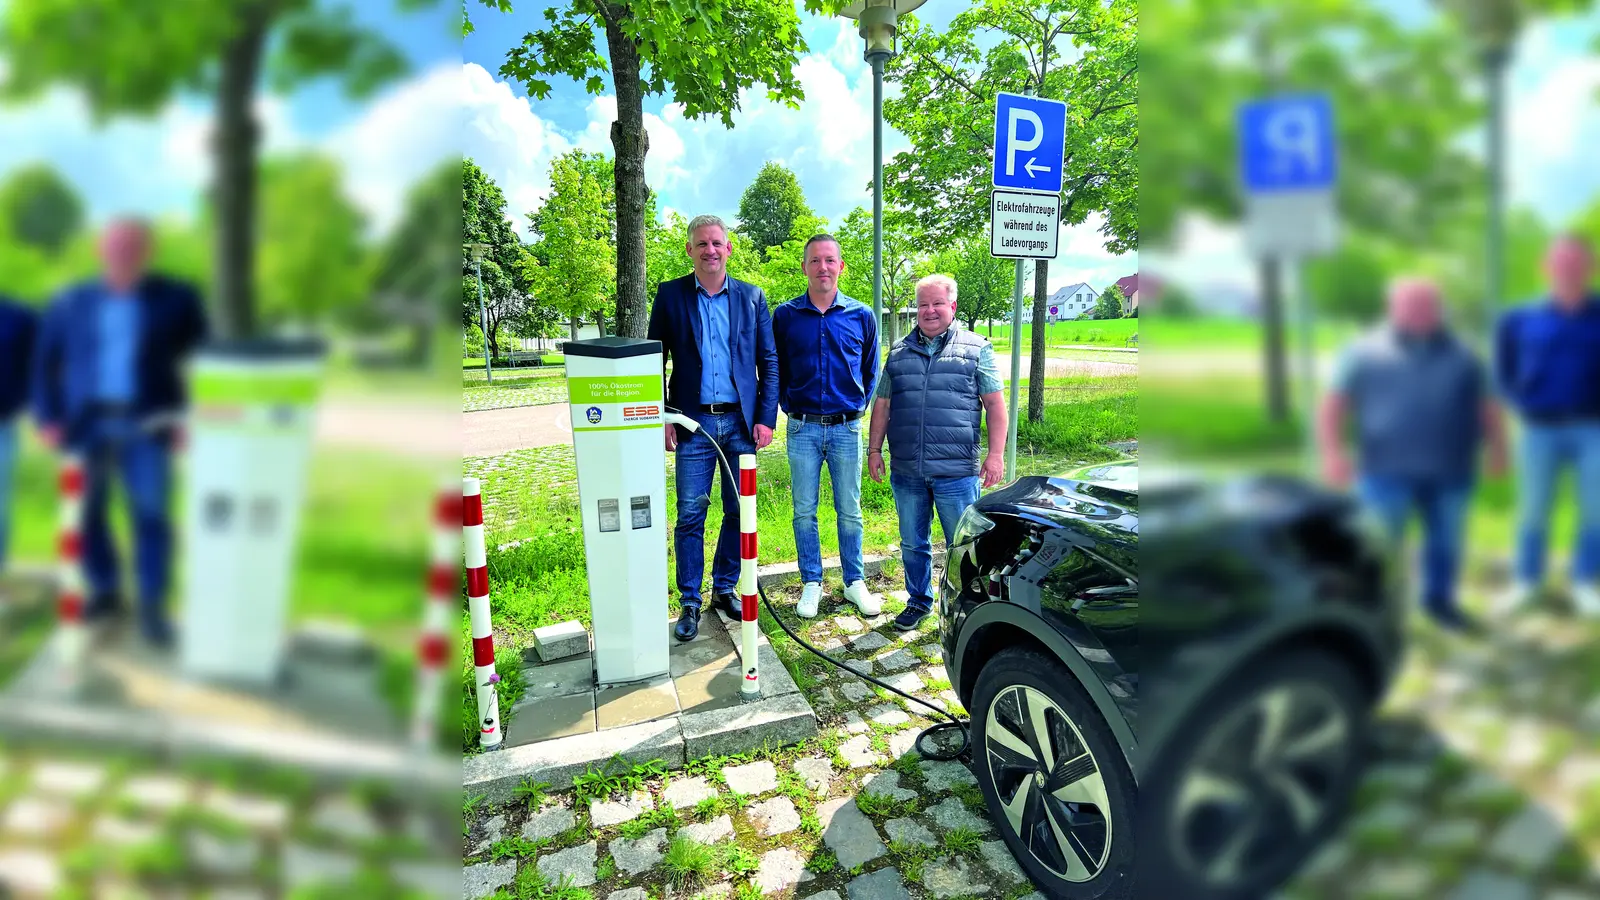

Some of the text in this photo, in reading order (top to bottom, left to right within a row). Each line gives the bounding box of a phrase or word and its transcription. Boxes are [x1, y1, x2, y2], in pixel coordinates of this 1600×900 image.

[1006, 107, 1044, 176] P
[996, 200, 1056, 217] Elektrofahrzeuge
[1004, 219, 1048, 232] während des
[1002, 236, 1048, 251] Ladevorgangs
[624, 406, 660, 416] ESB
